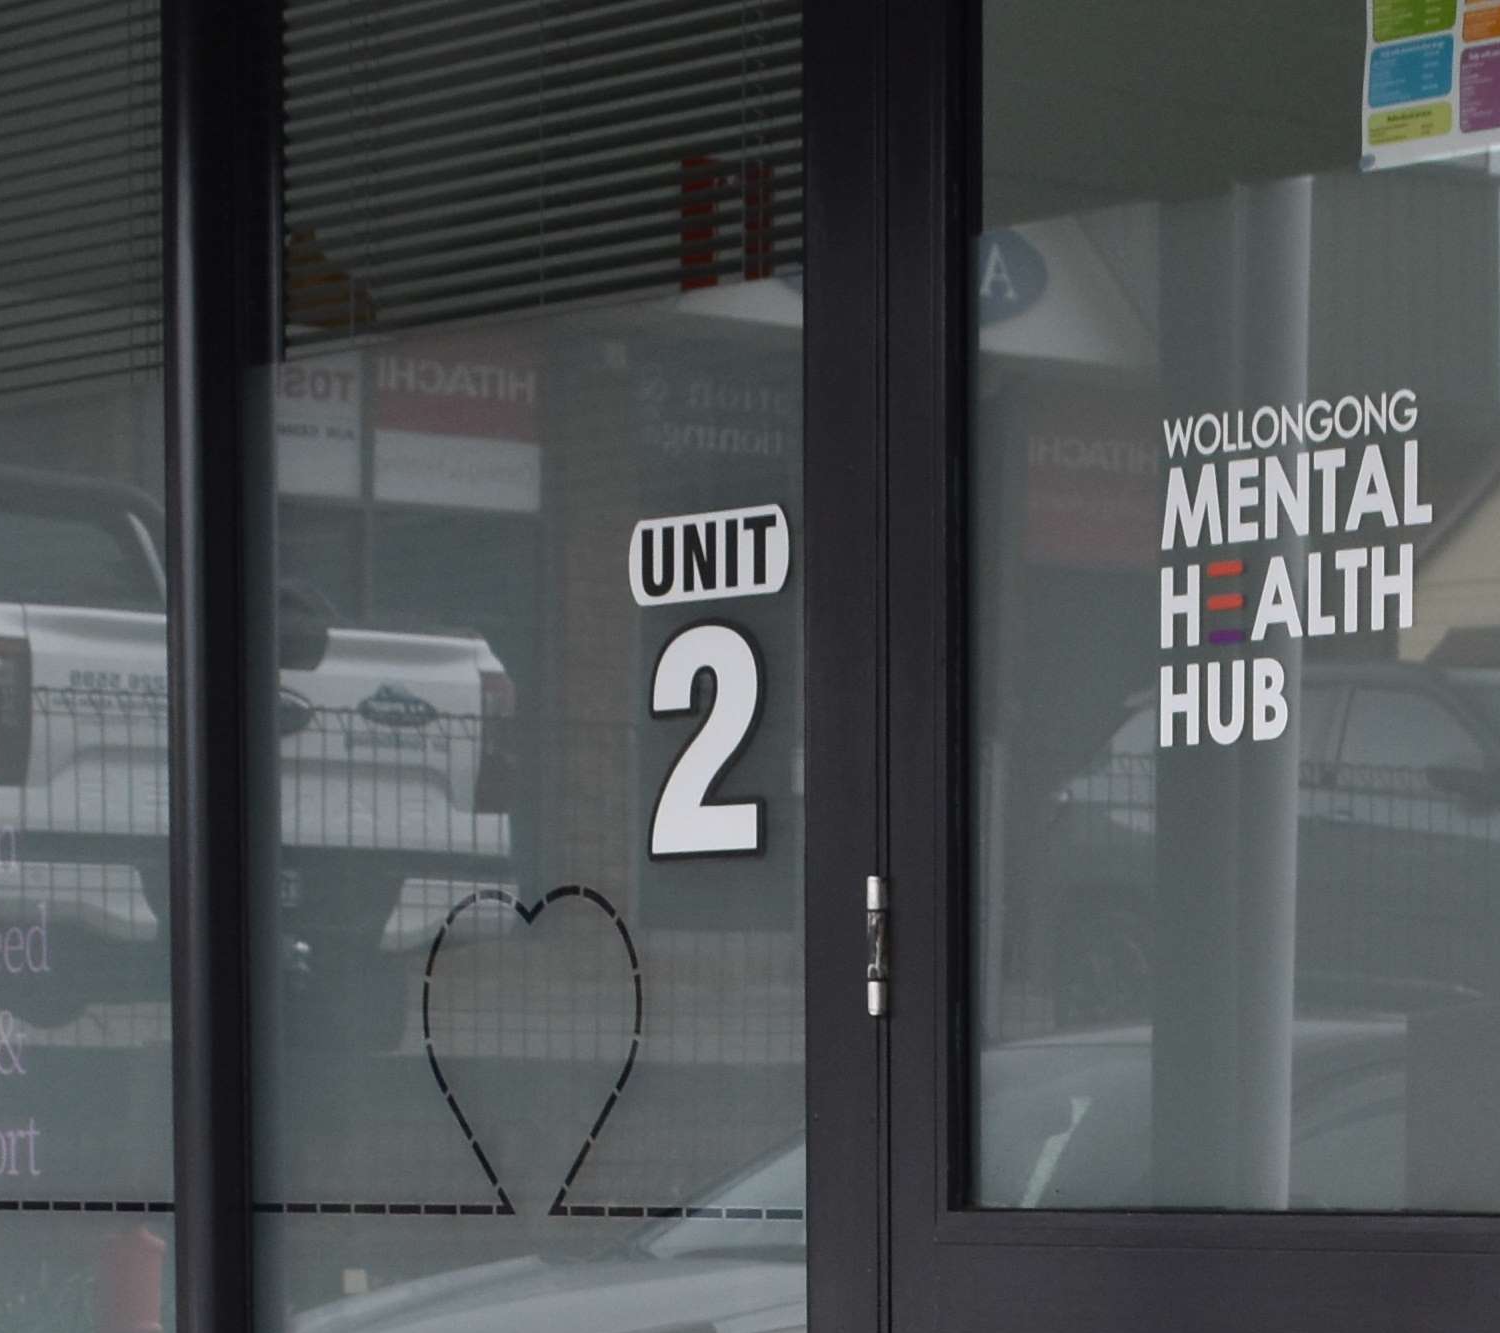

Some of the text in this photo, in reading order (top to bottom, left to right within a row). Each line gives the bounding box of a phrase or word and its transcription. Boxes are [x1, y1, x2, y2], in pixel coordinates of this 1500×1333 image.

[1163, 389, 1418, 458] WOLLONGONG
[1161, 440, 1433, 551] MENTAL
[641, 513, 777, 598] UNIT
[1160, 543, 1413, 649] HEALTH
[649, 620, 763, 859] 2
[1160, 658, 1288, 747] HUB
